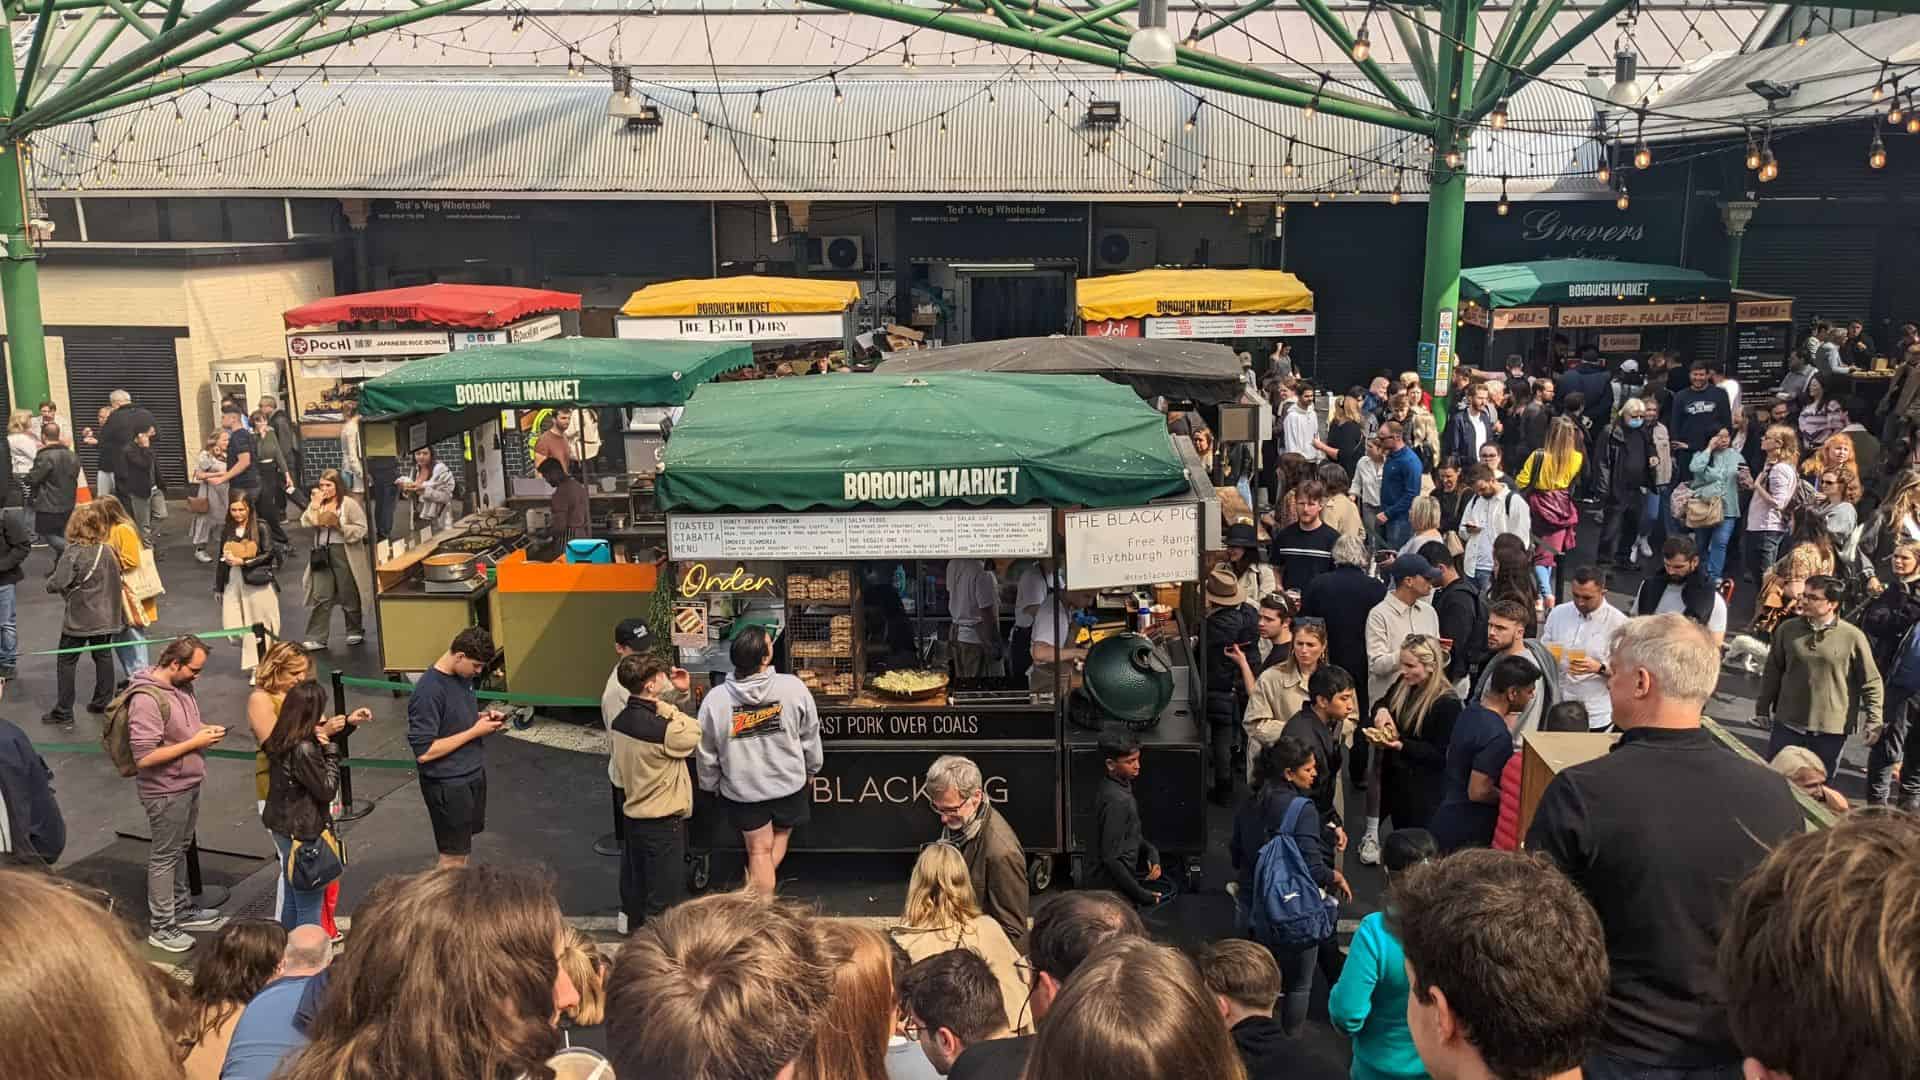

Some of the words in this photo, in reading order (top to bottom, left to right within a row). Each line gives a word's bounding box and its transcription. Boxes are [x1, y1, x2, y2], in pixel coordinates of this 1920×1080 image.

[975, 205, 994, 216] Veg
[995, 205, 1046, 214] Wholesale
[1522, 209, 1647, 241] Grovers
[1569, 284, 1610, 297] BOROUGH
[1611, 282, 1649, 296] MARKET
[697, 301, 735, 313] BOROUGH
[736, 301, 770, 313] MARKET
[1156, 300, 1195, 313] BOROUGH
[1197, 299, 1232, 312] MARKET
[1750, 306, 1779, 316] DELI
[1561, 313, 1592, 325] SALT
[1595, 313, 1628, 325] BEEF
[1640, 311, 1691, 323] FALAFEL
[216, 372, 248, 383] ATM
[456, 382, 520, 405] BOROUGH
[522, 380, 581, 400] MARKET
[843, 470, 935, 501] BOROUGH
[939, 467, 1020, 497] MARKET
[1067, 514, 1101, 529] THE
[1107, 510, 1164, 527] BLACK
[1170, 506, 1199, 521] PIG
[674, 522, 715, 531] TOASTED
[674, 533, 721, 543] CIABATTA
[1128, 536, 1155, 548] Free
[674, 544, 698, 554] MENU
[1093, 552, 1161, 565] Blythburgh
[682, 563, 774, 598] Order
[847, 716, 885, 735] PORK
[890, 716, 927, 734] OVER
[933, 715, 979, 734] COALS
[812, 775, 930, 803] BLACK
